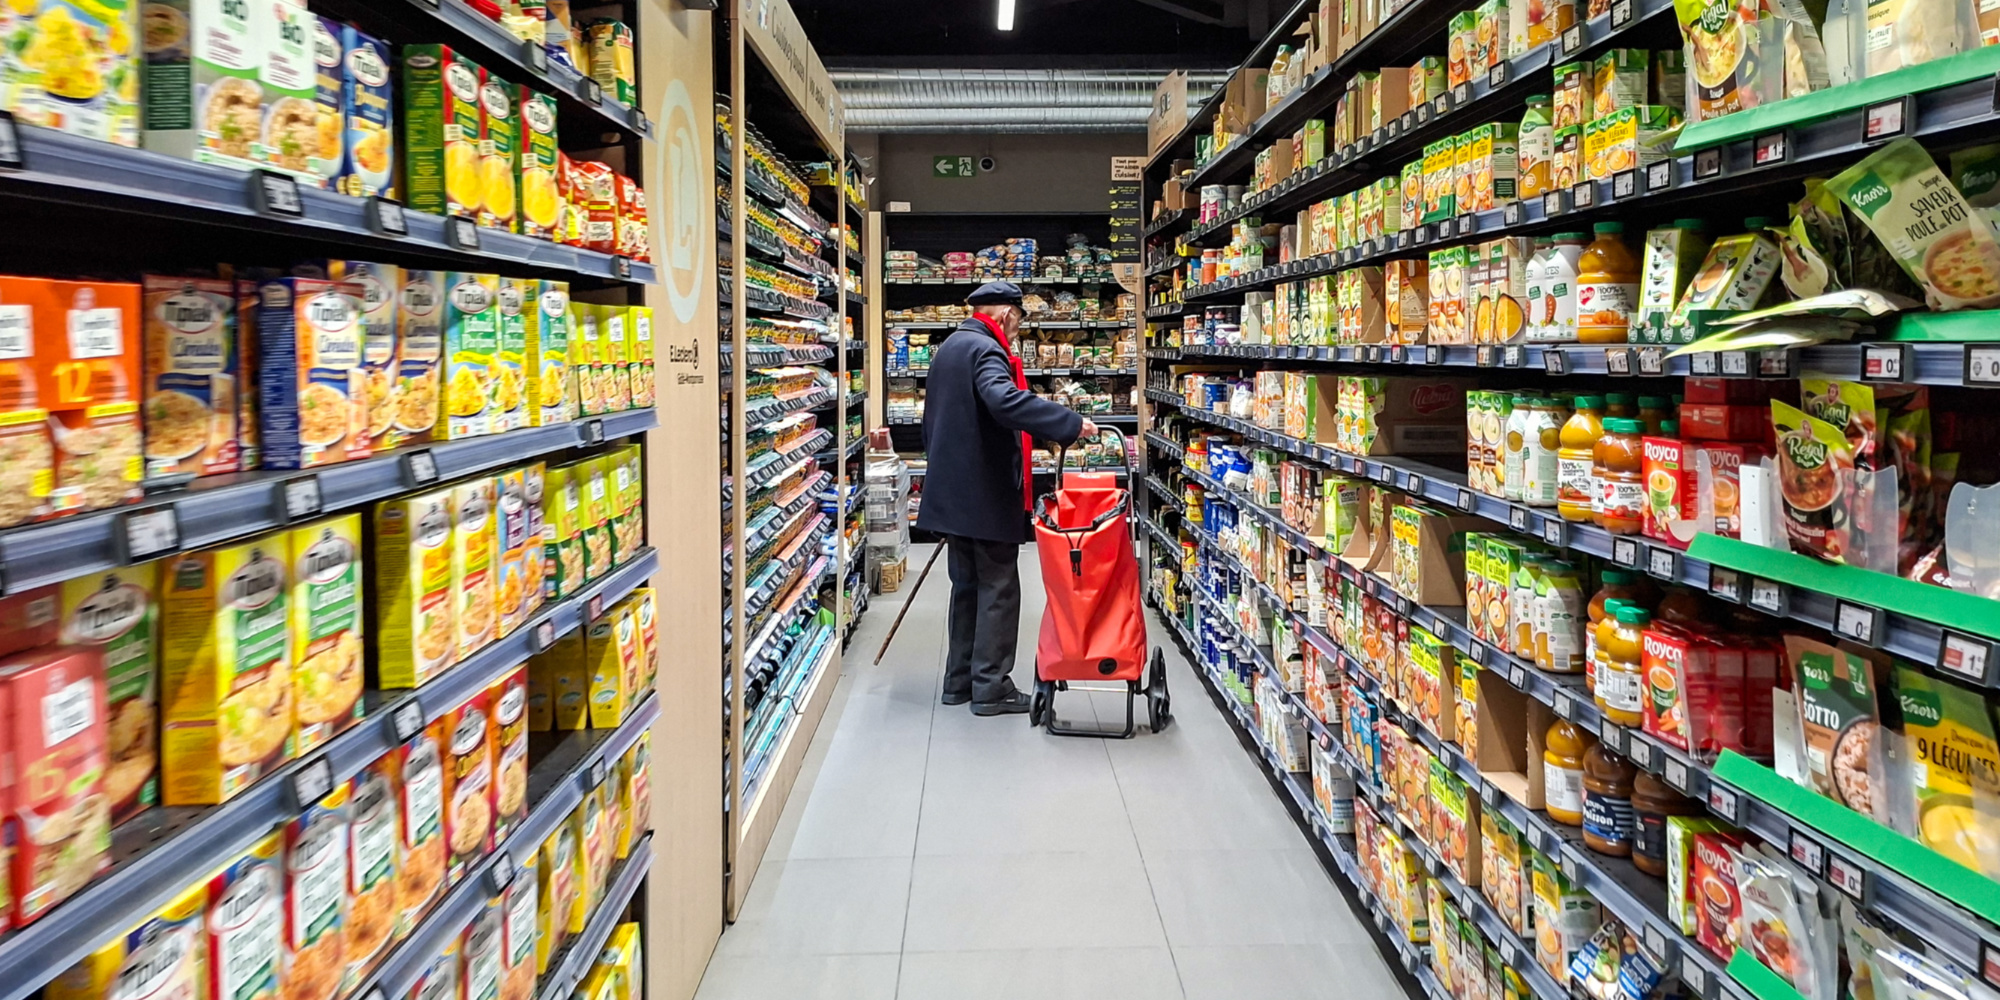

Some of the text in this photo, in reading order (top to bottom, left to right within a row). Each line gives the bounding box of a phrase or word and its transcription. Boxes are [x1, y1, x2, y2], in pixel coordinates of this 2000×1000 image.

[1851, 186, 1889, 208] Knorr
[1910, 186, 1958, 219] SAVEUR
[1905, 216, 1940, 243] POULE
[1941, 202, 1969, 226] POT
[1901, 696, 1940, 721] Knorr
[1917, 737, 1928, 760] 9
